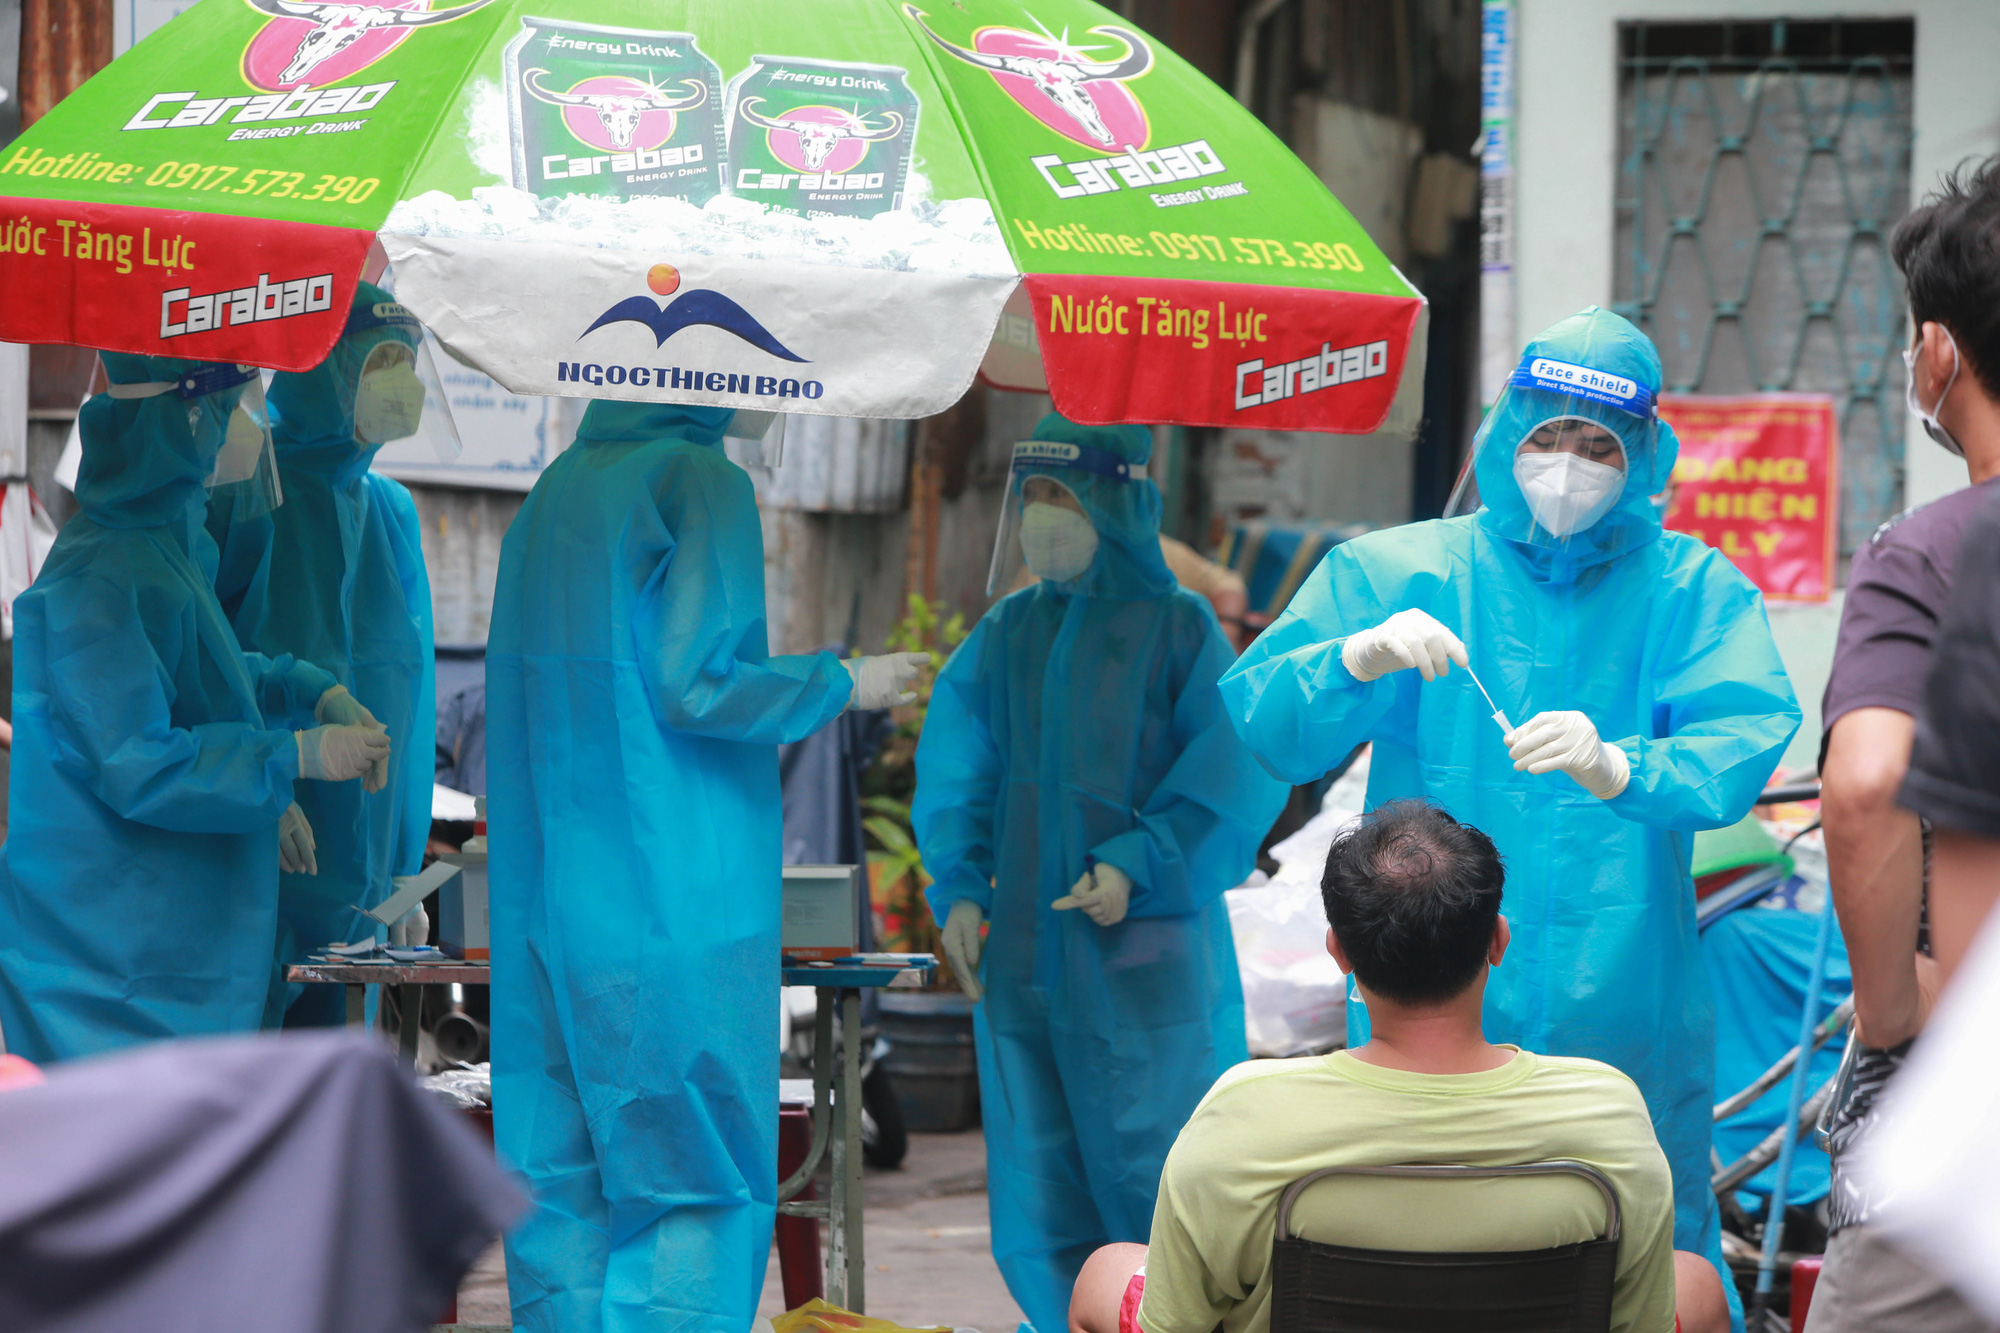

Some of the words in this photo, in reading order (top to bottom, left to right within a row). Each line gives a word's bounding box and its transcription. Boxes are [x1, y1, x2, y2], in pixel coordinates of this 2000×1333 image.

[550, 35, 621, 55] Energy
[626, 43, 682, 58] Drink
[772, 69, 837, 86] Energy
[841, 76, 889, 91] Drink
[121, 80, 398, 131] Carabao
[226, 125, 308, 141] ENERGY
[305, 118, 371, 135] DRINK
[1, 146, 144, 184] Hotline:
[145, 161, 380, 204] 0917.573.390
[542, 144, 703, 180] Carabao
[626, 171, 674, 183] ENERGY
[678, 166, 708, 177] DRINK
[1029, 139, 1227, 199] Carabao
[736, 169, 885, 190] Carabao
[809, 192, 853, 200] ENERGY
[855, 192, 884, 200] DRINK
[1150, 189, 1205, 208] ENERGY
[1203, 180, 1250, 200] DRINK
[0, 215, 47, 256] ước
[56, 219, 133, 274] Tăng
[143, 227, 196, 275] Lực
[1013, 218, 1154, 257] Hotline:
[1149, 230, 1365, 272] 0917.573.390
[160, 272, 333, 339] Carabao
[1050, 294, 1129, 335] Nước
[1137, 297, 1210, 349] Tăng
[1218, 302, 1268, 348] Lực
[1235, 341, 1388, 411] Carabao
[1536, 379, 1558, 389] Direct
[1559, 383, 1585, 395] Splash
[1586, 389, 1624, 405] protection
[1538, 363, 1574, 379] Face
[1580, 373, 1629, 394] shield
